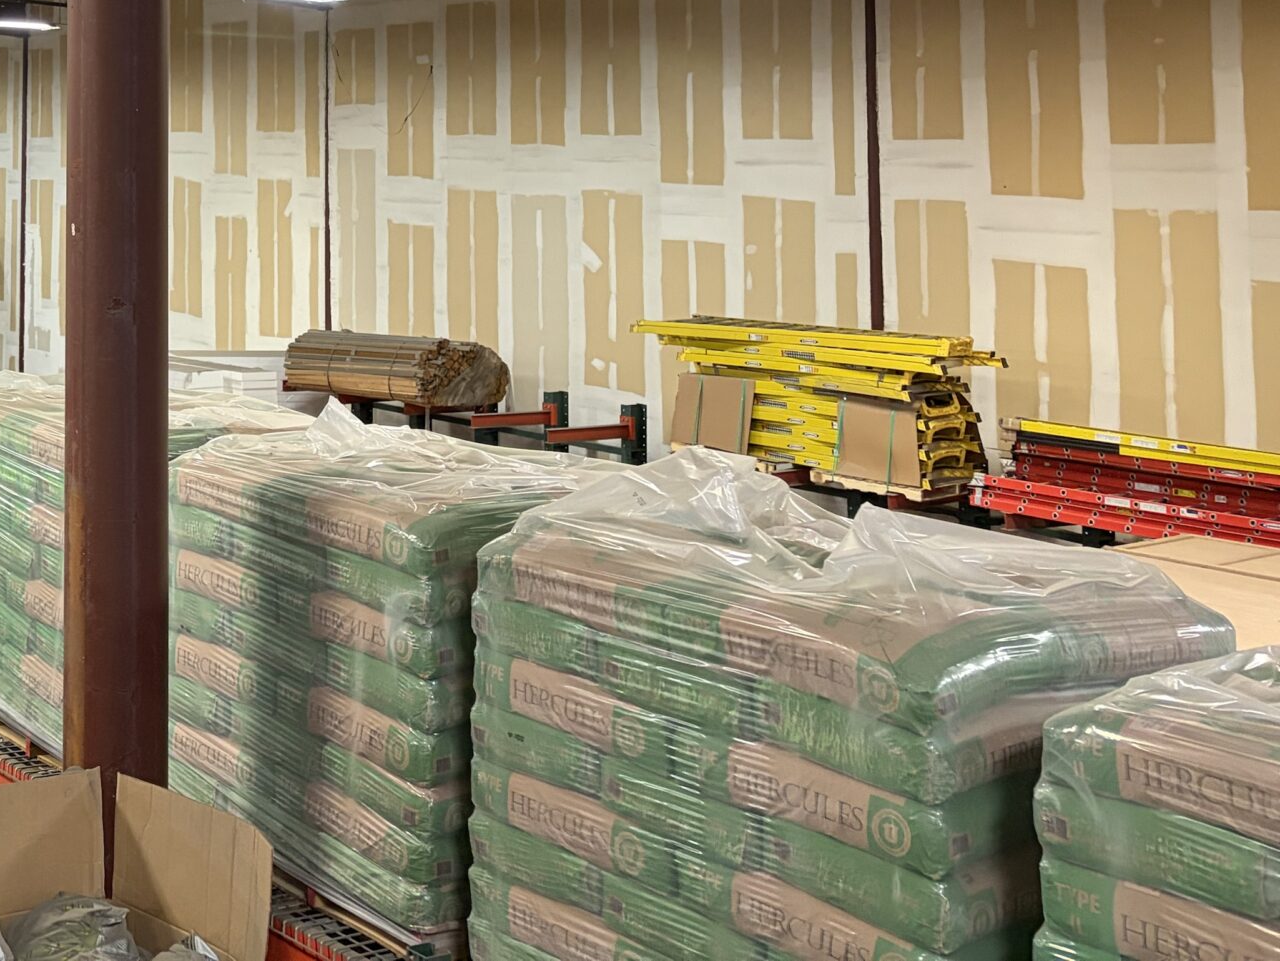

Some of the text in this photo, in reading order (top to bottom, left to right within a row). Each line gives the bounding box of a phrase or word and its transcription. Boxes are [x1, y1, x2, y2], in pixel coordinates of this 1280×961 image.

[312, 602, 388, 649] HERCULES
[480, 660, 505, 682] TYPE
[731, 765, 864, 833] HERCULES
[1055, 882, 1102, 914] TYPE
[736, 891, 871, 961] HERCULES
